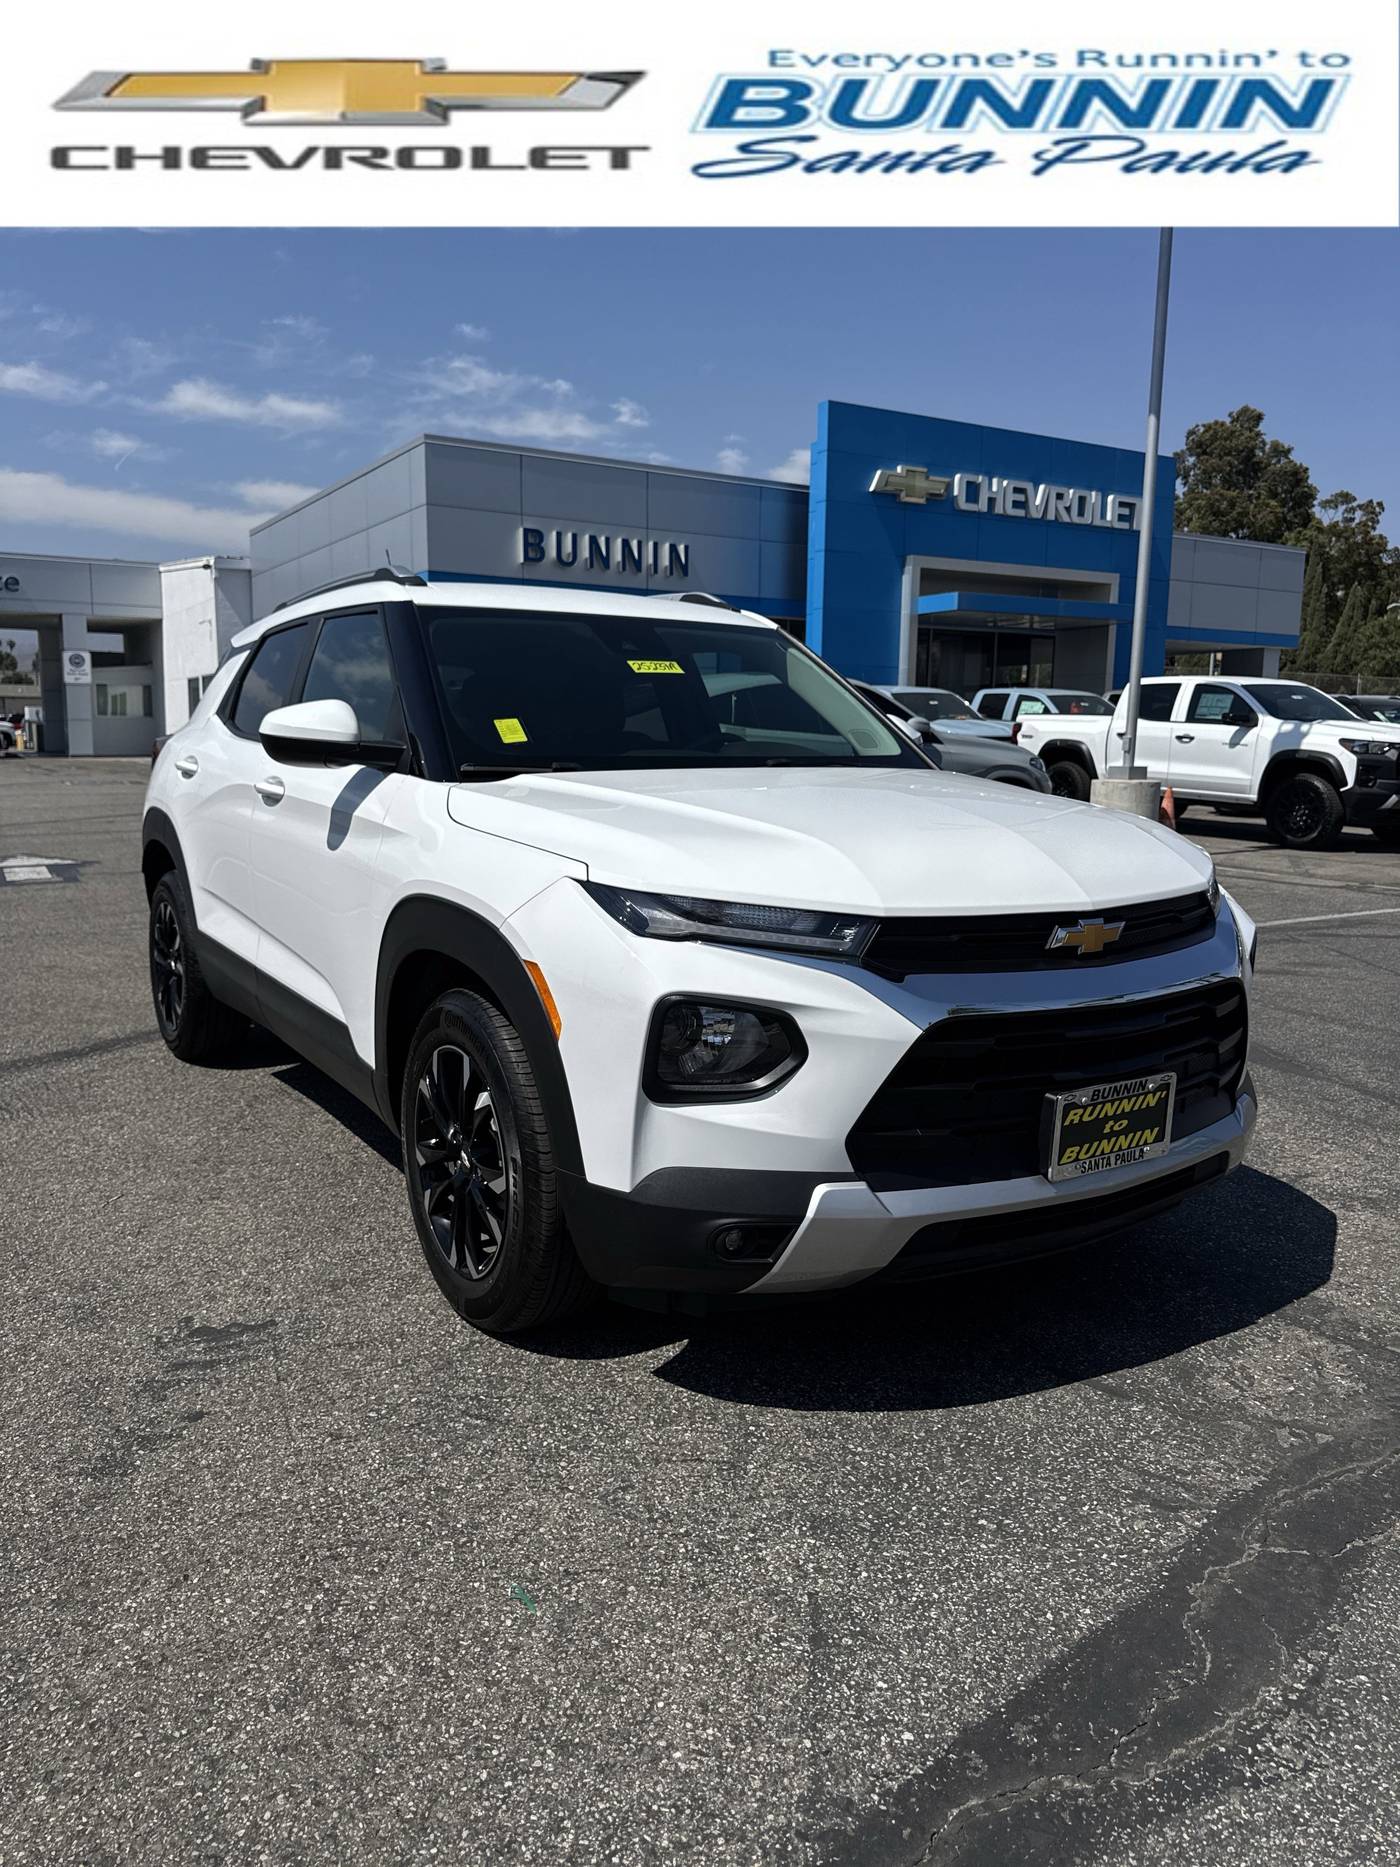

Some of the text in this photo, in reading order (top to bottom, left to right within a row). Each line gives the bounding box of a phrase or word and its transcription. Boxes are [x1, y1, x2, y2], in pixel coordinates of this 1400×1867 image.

[954, 472, 1144, 531] CHEVROLET
[519, 526, 690, 578] BUNNIN
[1064, 1090, 1168, 1126] RUNNIN'
[1090, 1079, 1149, 1102] BUNNIN
[1103, 1119, 1129, 1134] to
[1059, 1126, 1160, 1165] BUNNIN
[1081, 1147, 1145, 1174] SANTA PAULA
